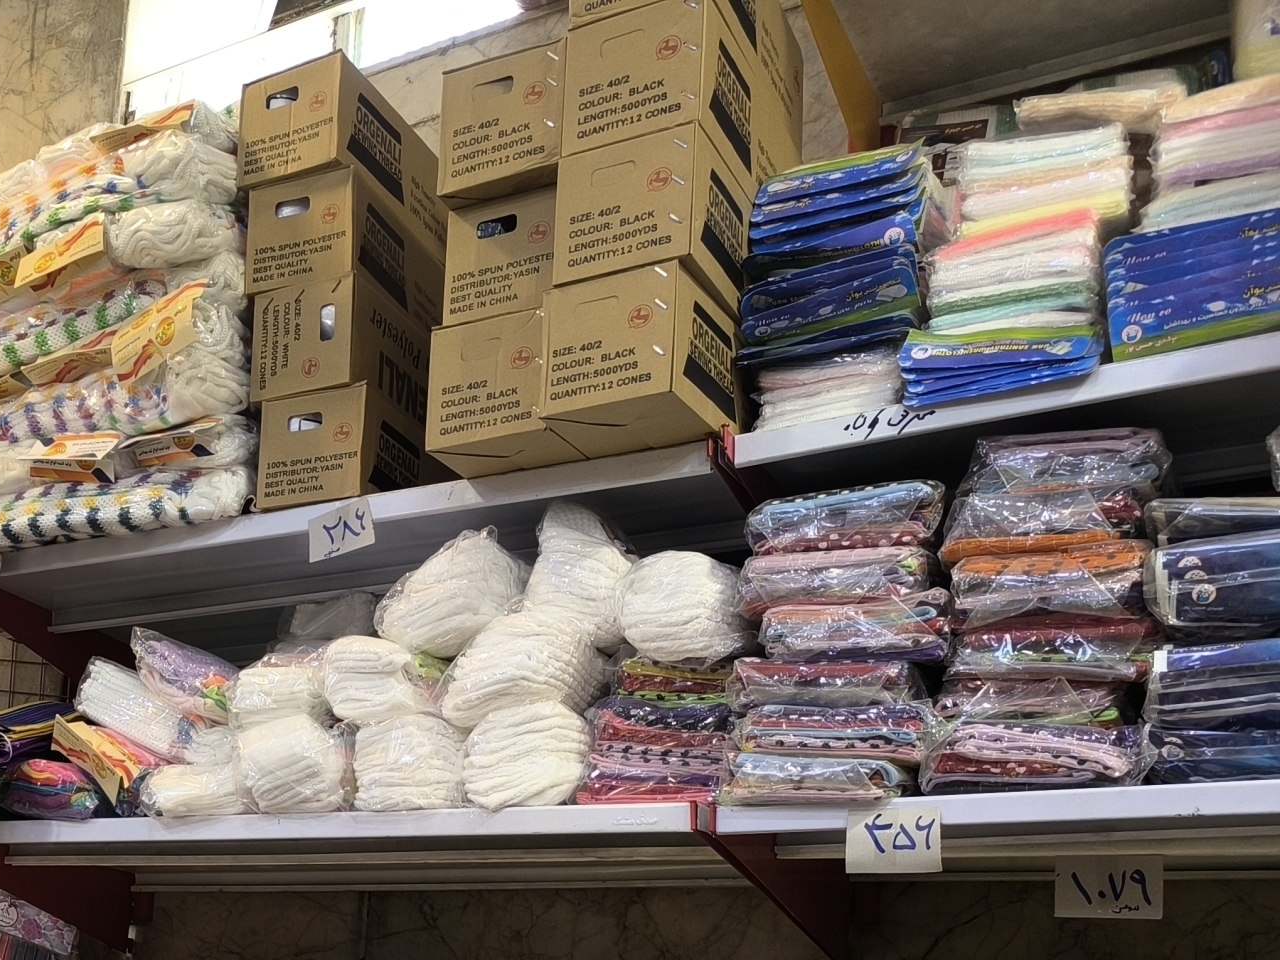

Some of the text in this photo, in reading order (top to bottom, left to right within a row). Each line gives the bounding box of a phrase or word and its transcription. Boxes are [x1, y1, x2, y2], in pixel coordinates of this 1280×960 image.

[578, 78, 665, 111] COLOUR: BLACK
[579, 75, 630, 98] SIZE: 40/2
[645, 103, 681, 119] CONES
[246, 117, 333, 148] 100% SPUN POLYESTER
[356, 106, 402, 165] ORGENALI
[453, 118, 499, 137] SIZE: 40/2
[453, 122, 531, 151] COLOUR: BLACK
[244, 148, 297, 167] BEST QUALITY
[513, 146, 545, 160] CONES
[244, 165, 264, 176] MADE
[278, 155, 301, 168] CHINA
[569, 210, 655, 239] COLOUR: BLACK
[570, 205, 621, 225] SIZE: 40/2
[709, 185, 743, 250] ORGENALI
[255, 230, 346, 256] 100% SPUN POLYESTER
[636, 235, 672, 251] CONES
[253, 258, 308, 274] BEST QUALITY
[253, 266, 313, 283] MADE CHINA
[452, 271, 475, 283] 100%
[478, 265, 503, 277] SPUN
[450, 284, 513, 305] BEST QUALITY
[450, 293, 518, 315] MADE CHINA
[552, 340, 602, 358] SIZE: 40/2
[692, 318, 733, 372] ORGENALI
[281, 343, 290, 369] WHITE
[551, 347, 636, 372] COLOUR: BLACK
[441, 380, 487, 395] SIZE: 40/2
[617, 372, 652, 387] CONES
[441, 387, 518, 409] COLOUR: BLACK
[500, 411, 532, 424] CONES
[267, 451, 358, 469] 100% SPUN POLYESTER
[264, 484, 323, 498] MADE CHINA
[265, 475, 319, 489] BEST QUALITY
